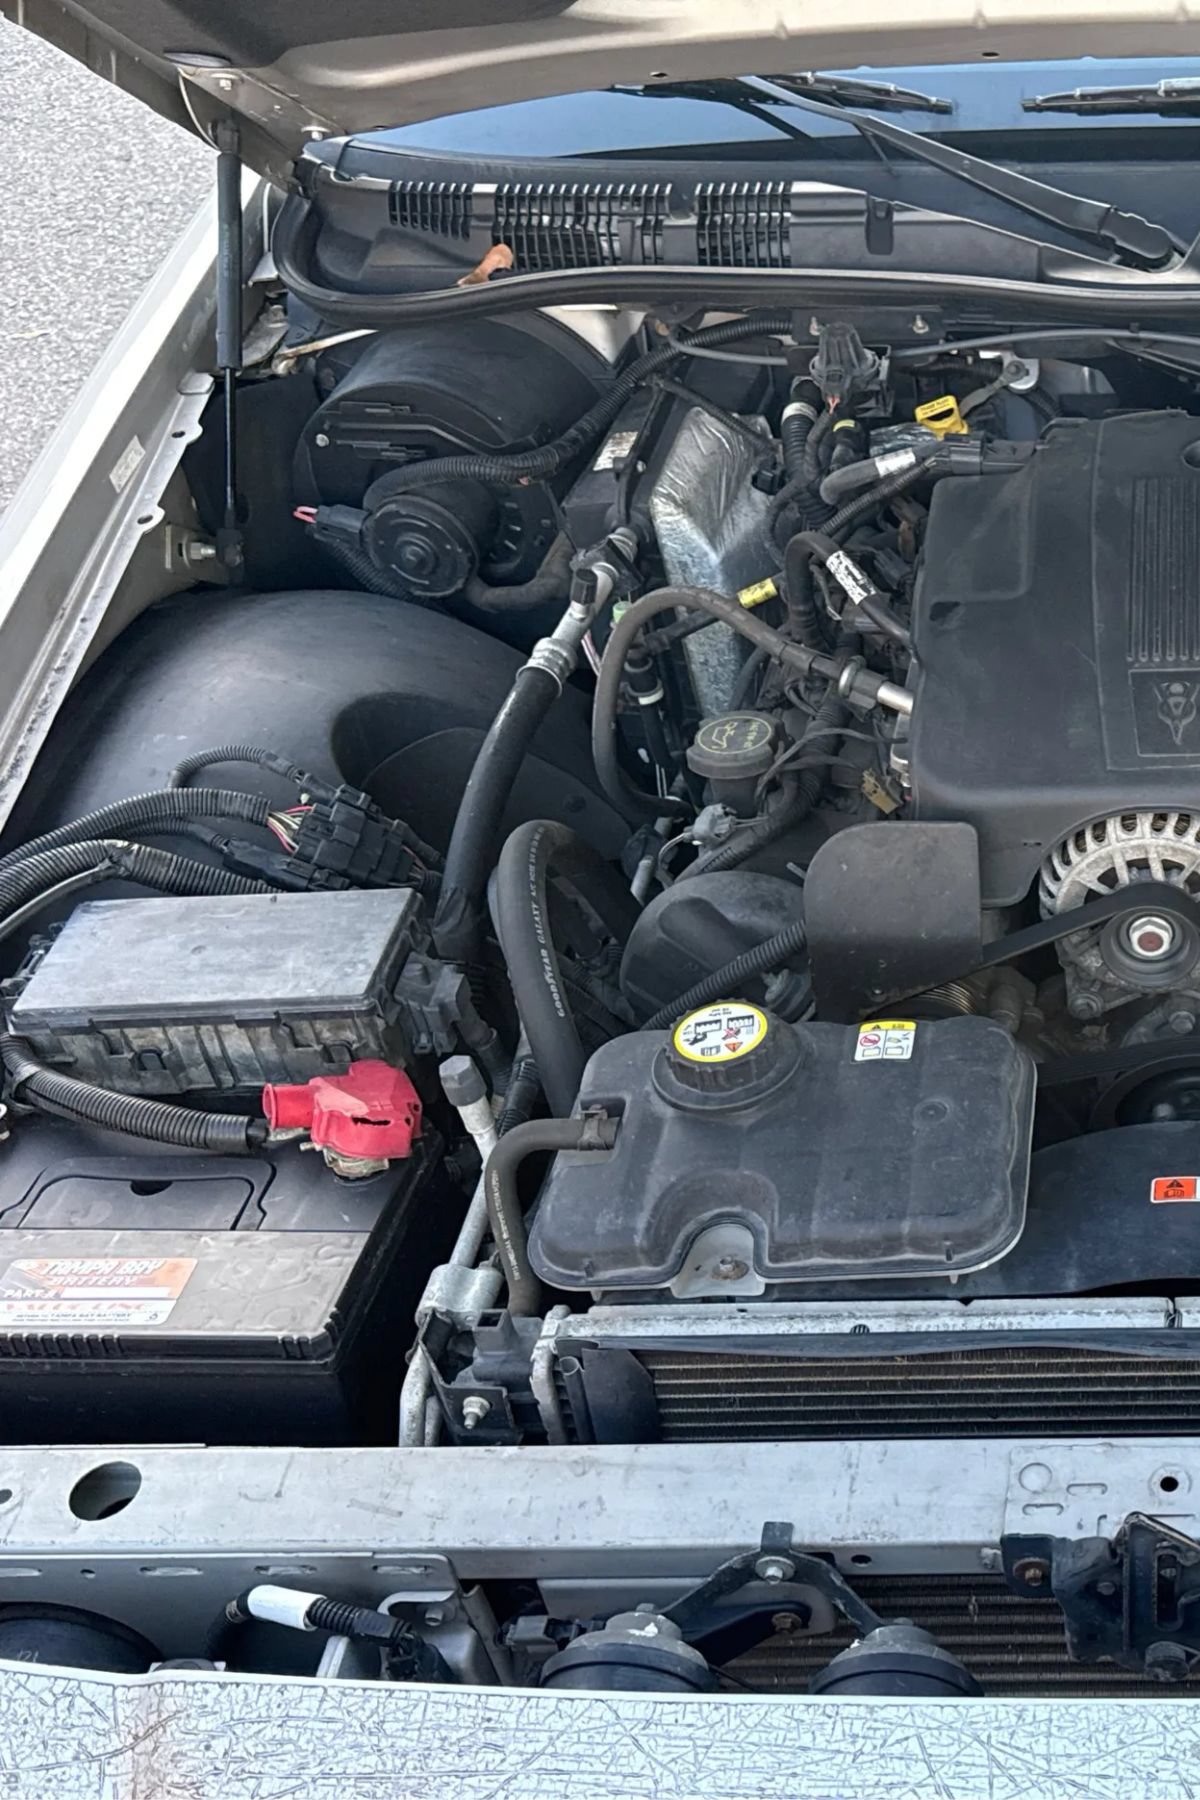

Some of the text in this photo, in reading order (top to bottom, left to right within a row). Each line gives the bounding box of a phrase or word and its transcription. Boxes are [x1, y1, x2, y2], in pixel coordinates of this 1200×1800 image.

[530, 901, 546, 944] GALAXY
[540, 948, 566, 1018] GOODYEAR
[40, 1259, 163, 1275] TAMPA BAY
[48, 1275, 138, 1286] BATTERY
